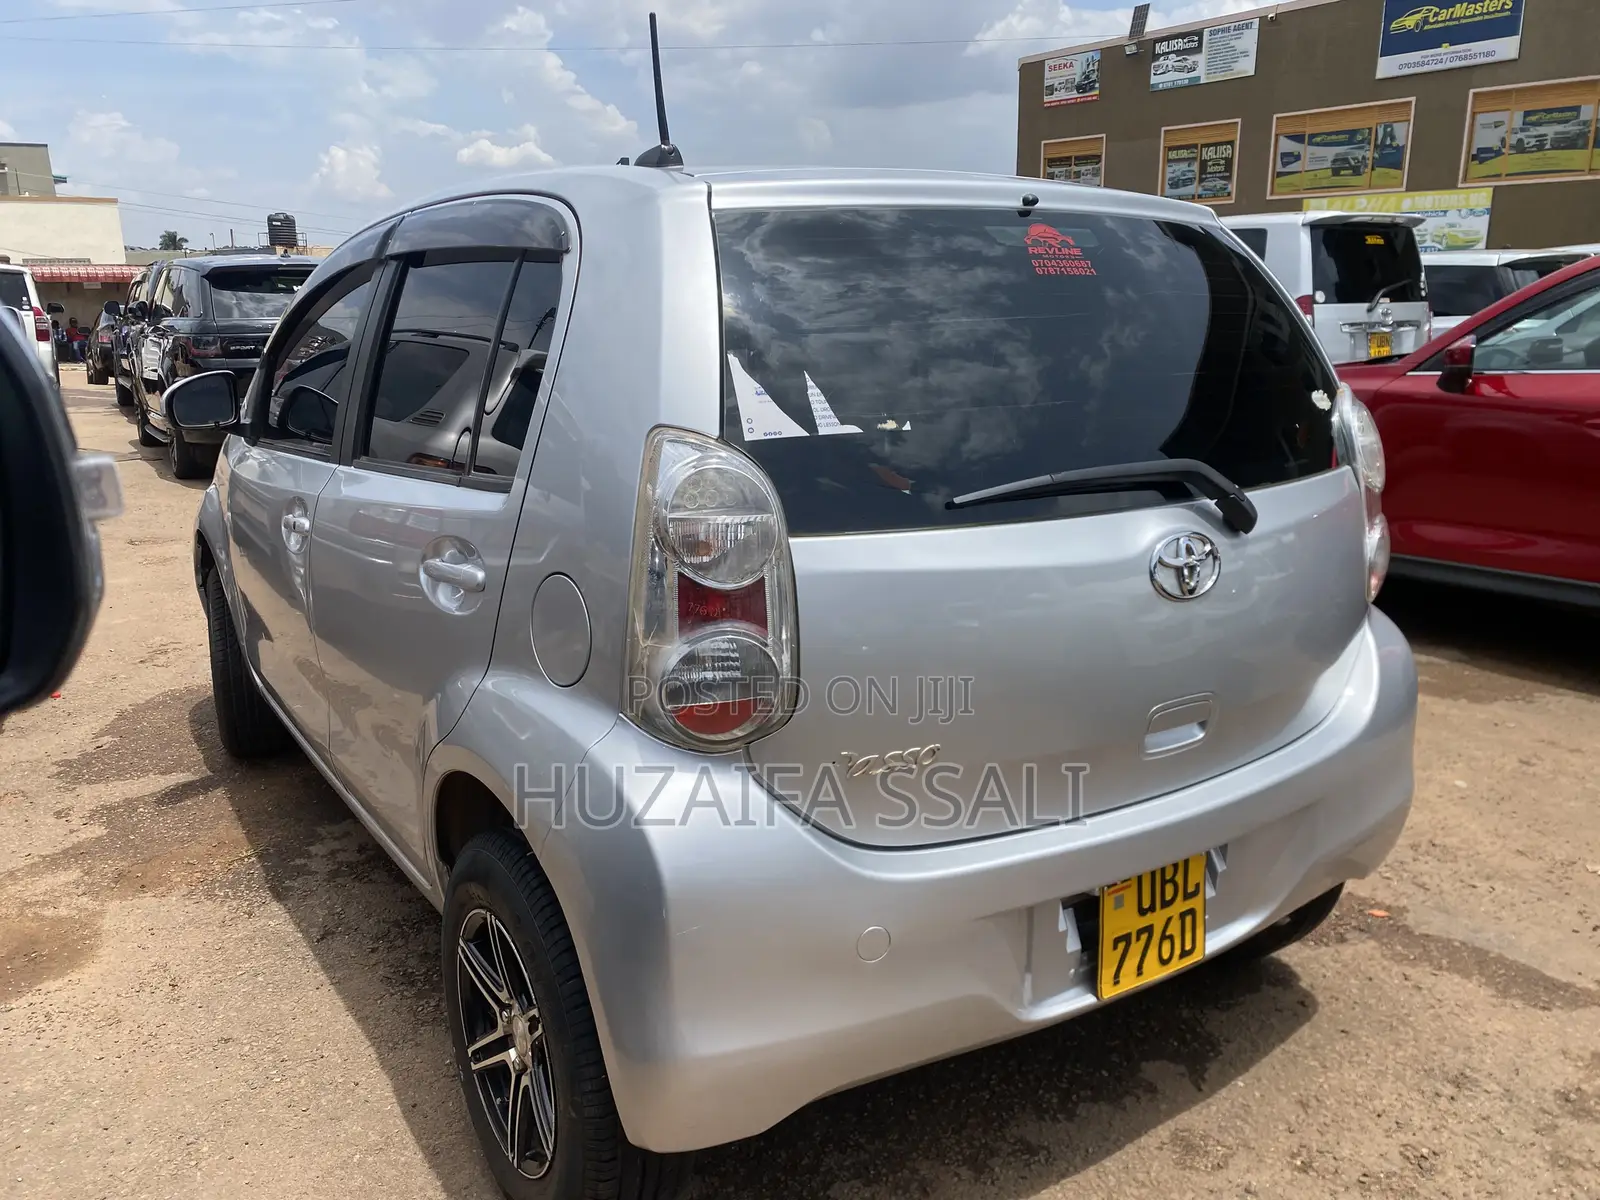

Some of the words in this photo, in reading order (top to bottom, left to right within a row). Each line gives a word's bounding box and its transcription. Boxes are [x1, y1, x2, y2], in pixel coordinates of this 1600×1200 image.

[1428, 0, 1513, 23] CarMasters
[1208, 26, 1231, 37] SOPHIE
[1233, 21, 1254, 32] AGENT
[1048, 61, 1075, 72] SEEKA
[1398, 57, 1444, 71] 0703584724
[1449, 50, 1496, 63] 0768551180
[1028, 247, 1083, 255] REVLINE
[1137, 857, 1201, 917] UBL
[1112, 907, 1197, 986] 776D
